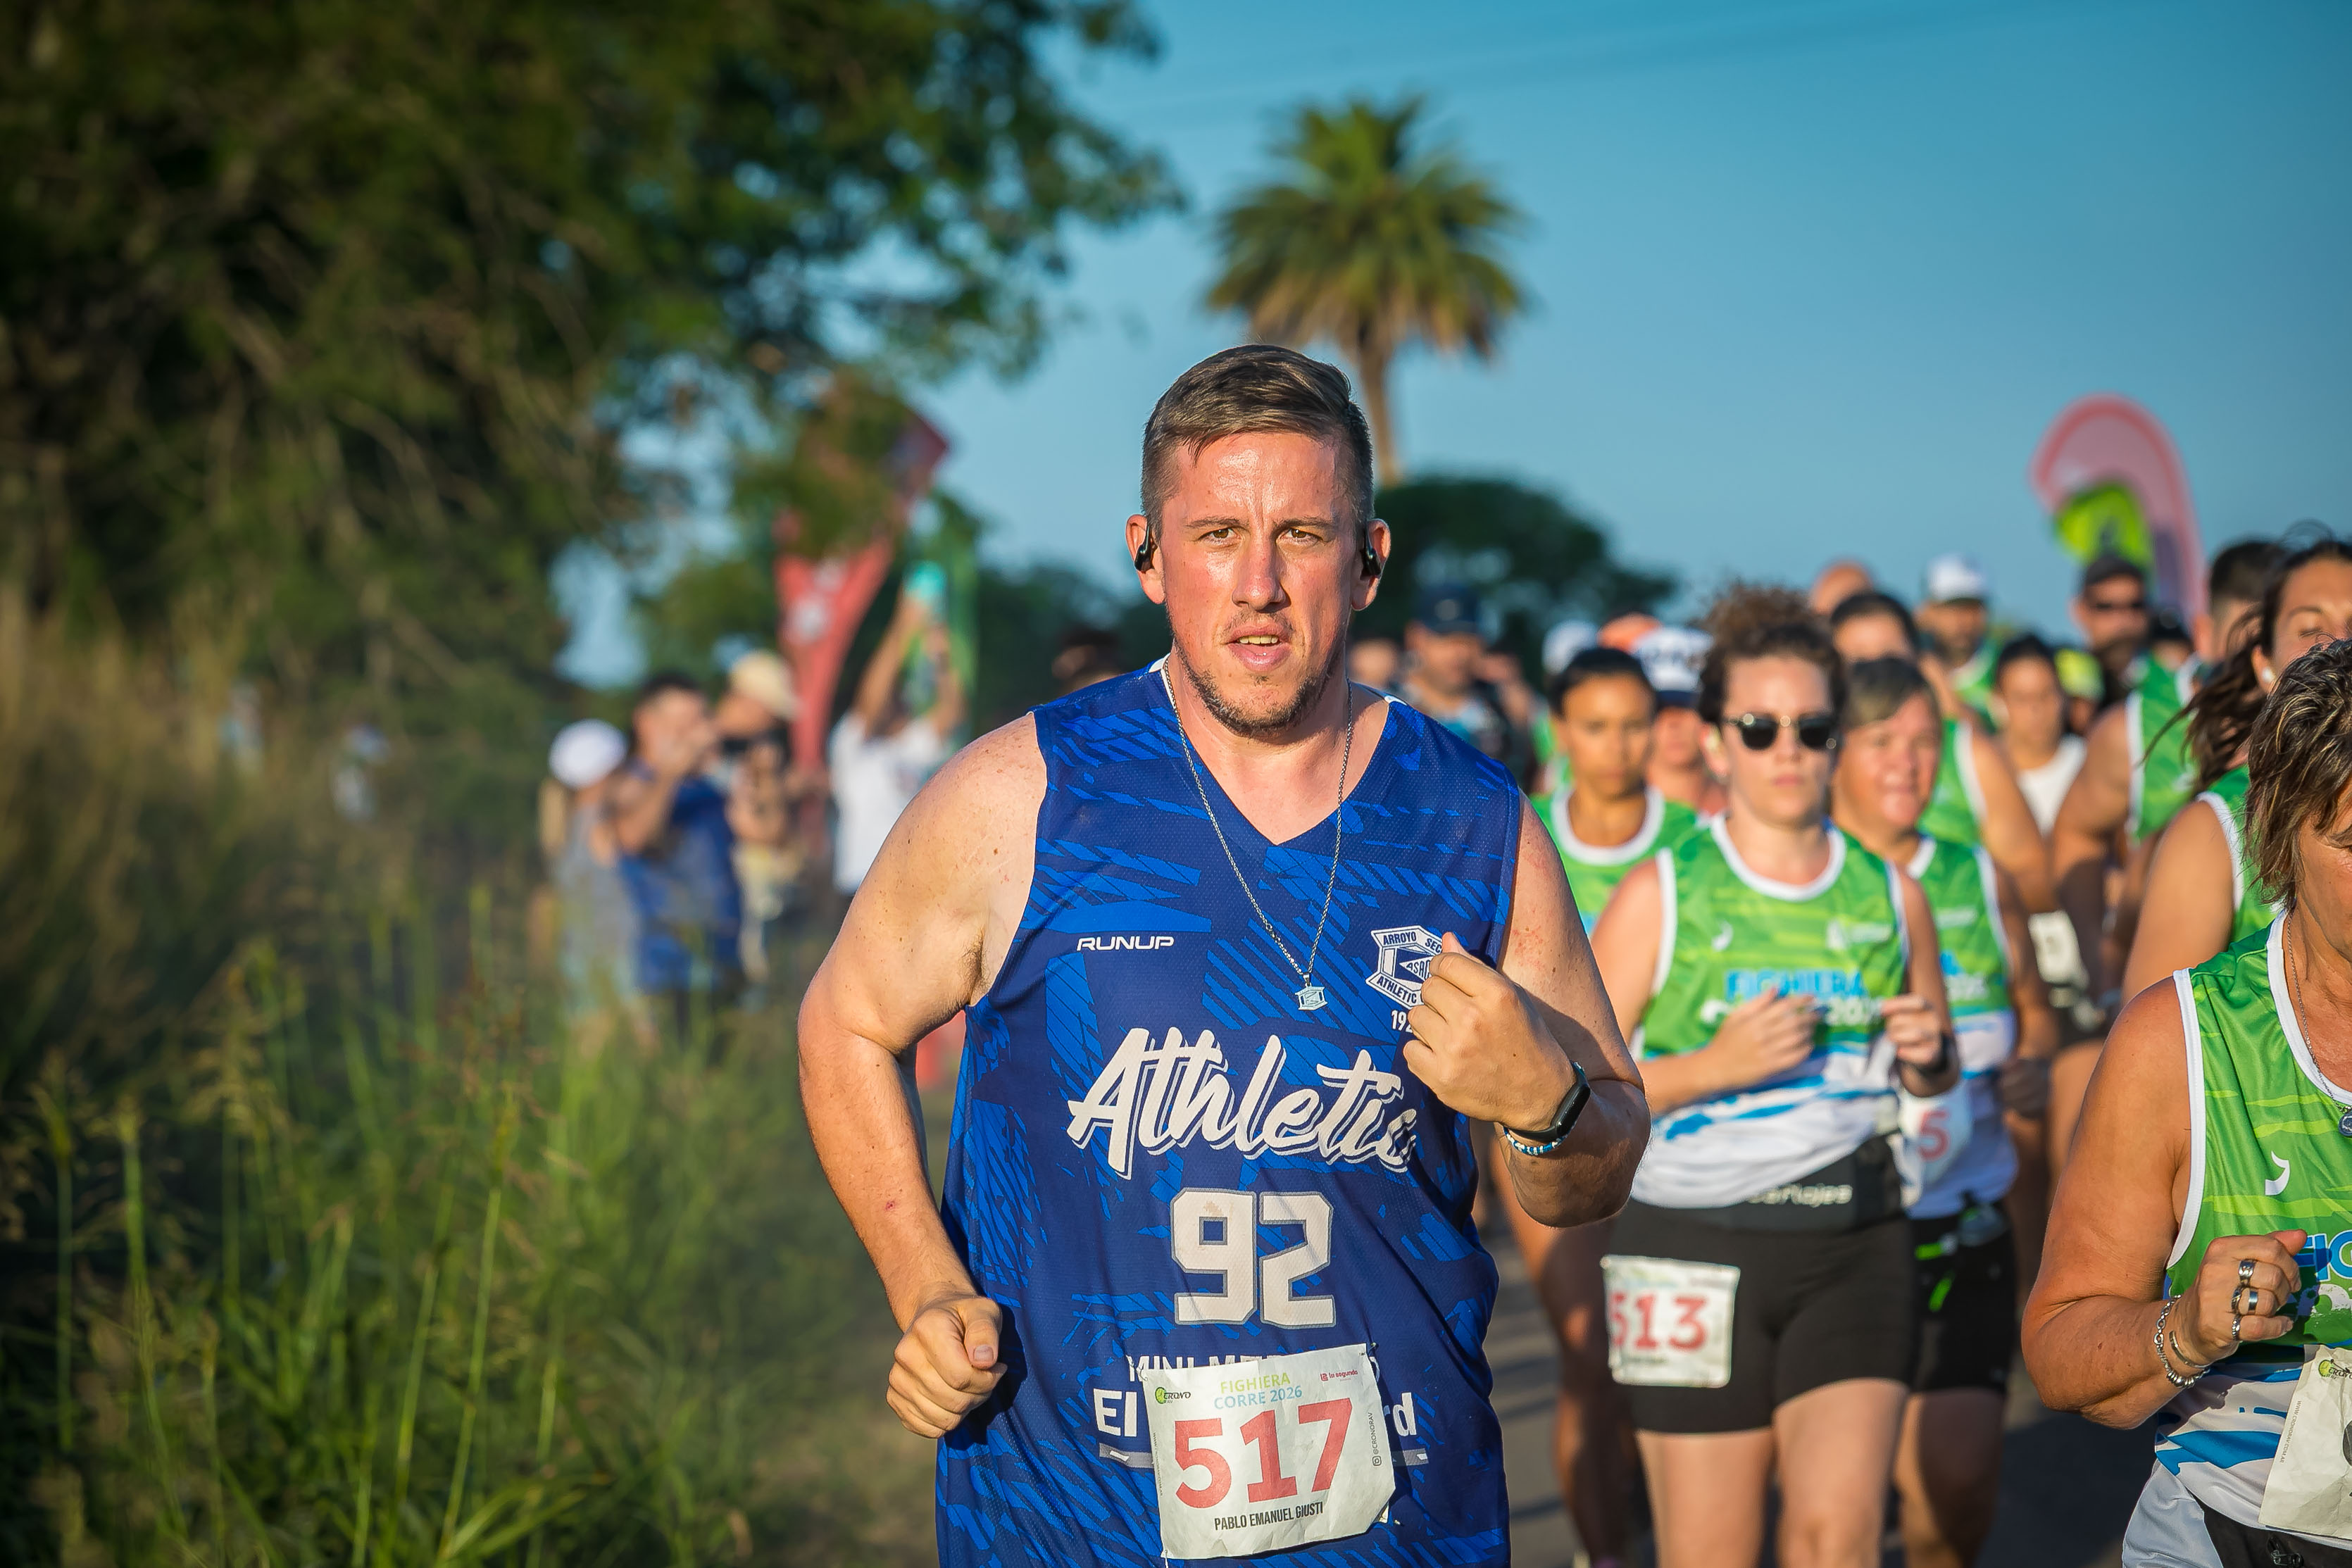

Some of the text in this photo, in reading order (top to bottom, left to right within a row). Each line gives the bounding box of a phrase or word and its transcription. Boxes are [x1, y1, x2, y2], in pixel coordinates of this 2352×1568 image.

[1076, 935, 1175, 951] RUNUP
[1383, 931, 1442, 954] ARROYO SEC
[1376, 975, 1417, 1004] ATHLETIC
[1066, 1026, 1417, 1181] Athletic
[1170, 1187, 1337, 1329] 92
[1220, 1372, 1291, 1393] FIGHIERA
[1214, 1385, 1303, 1410] CORRE 2026
[1368, 1412, 1379, 1455] @CRONORAV
[1175, 1397, 1353, 1510] 517
[1214, 1501, 1323, 1531] PABLO EMANUEL GIUSTI
